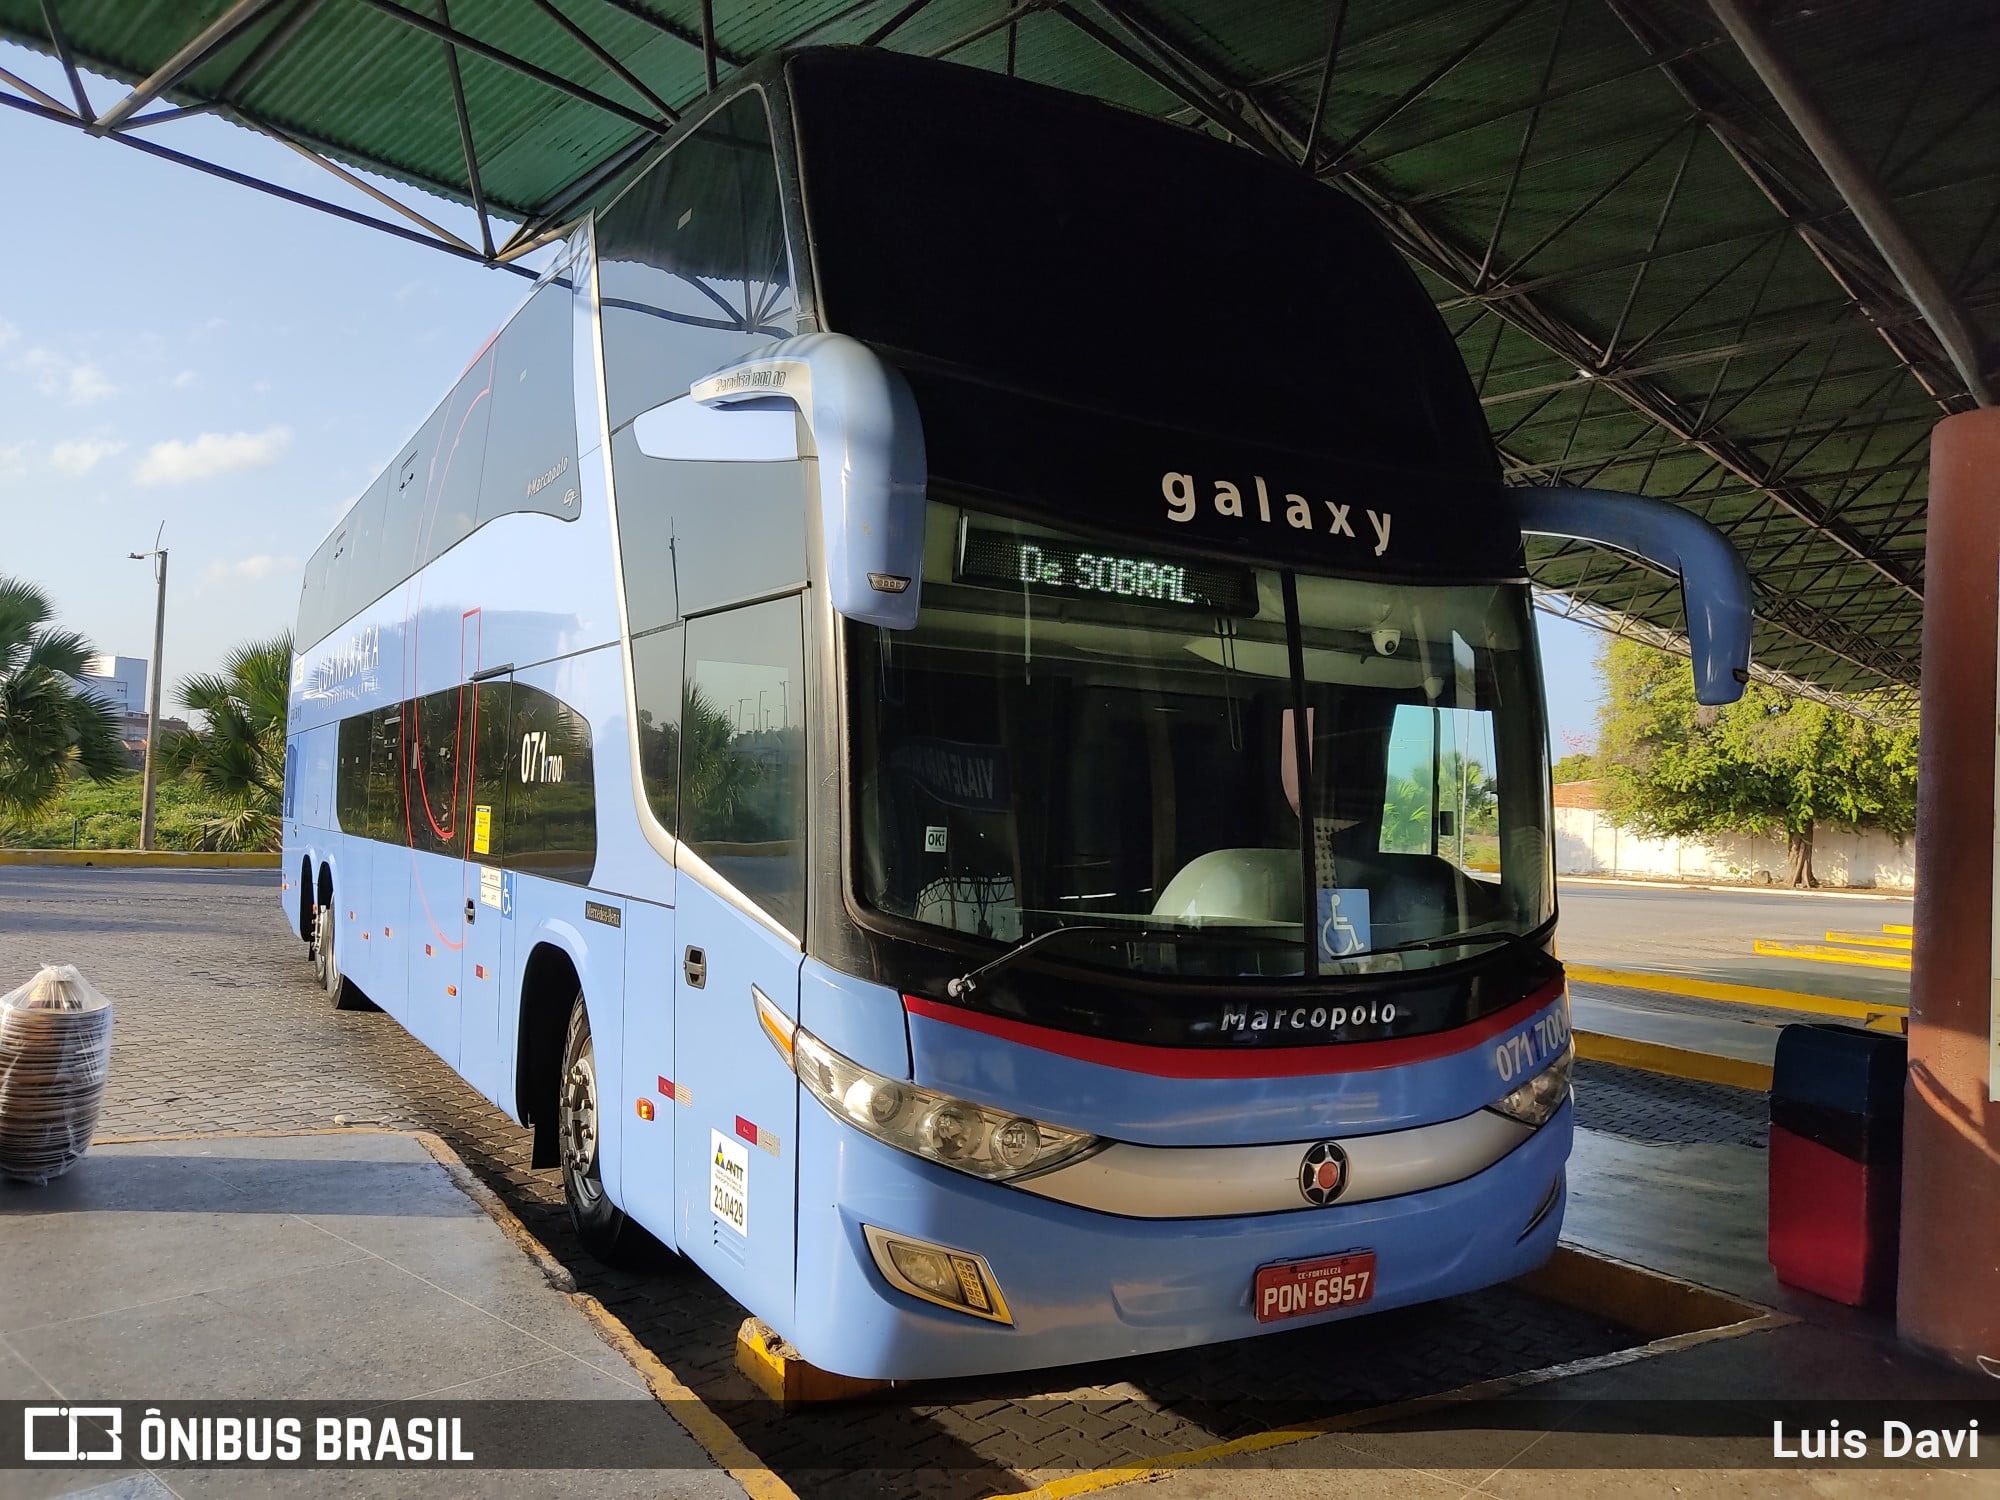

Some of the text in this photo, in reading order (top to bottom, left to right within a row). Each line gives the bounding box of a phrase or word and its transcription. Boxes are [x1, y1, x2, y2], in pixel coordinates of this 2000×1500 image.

[531, 456, 568, 495] Marcopolo
[1161, 471, 1392, 557] galaxy
[1020, 544, 1195, 604] De SOBRAL
[927, 833, 945, 847] OK!
[1220, 1000, 1396, 1031] Marcopolo
[725, 1159, 744, 1182] ANTT
[714, 1184, 744, 1227] 23.0429
